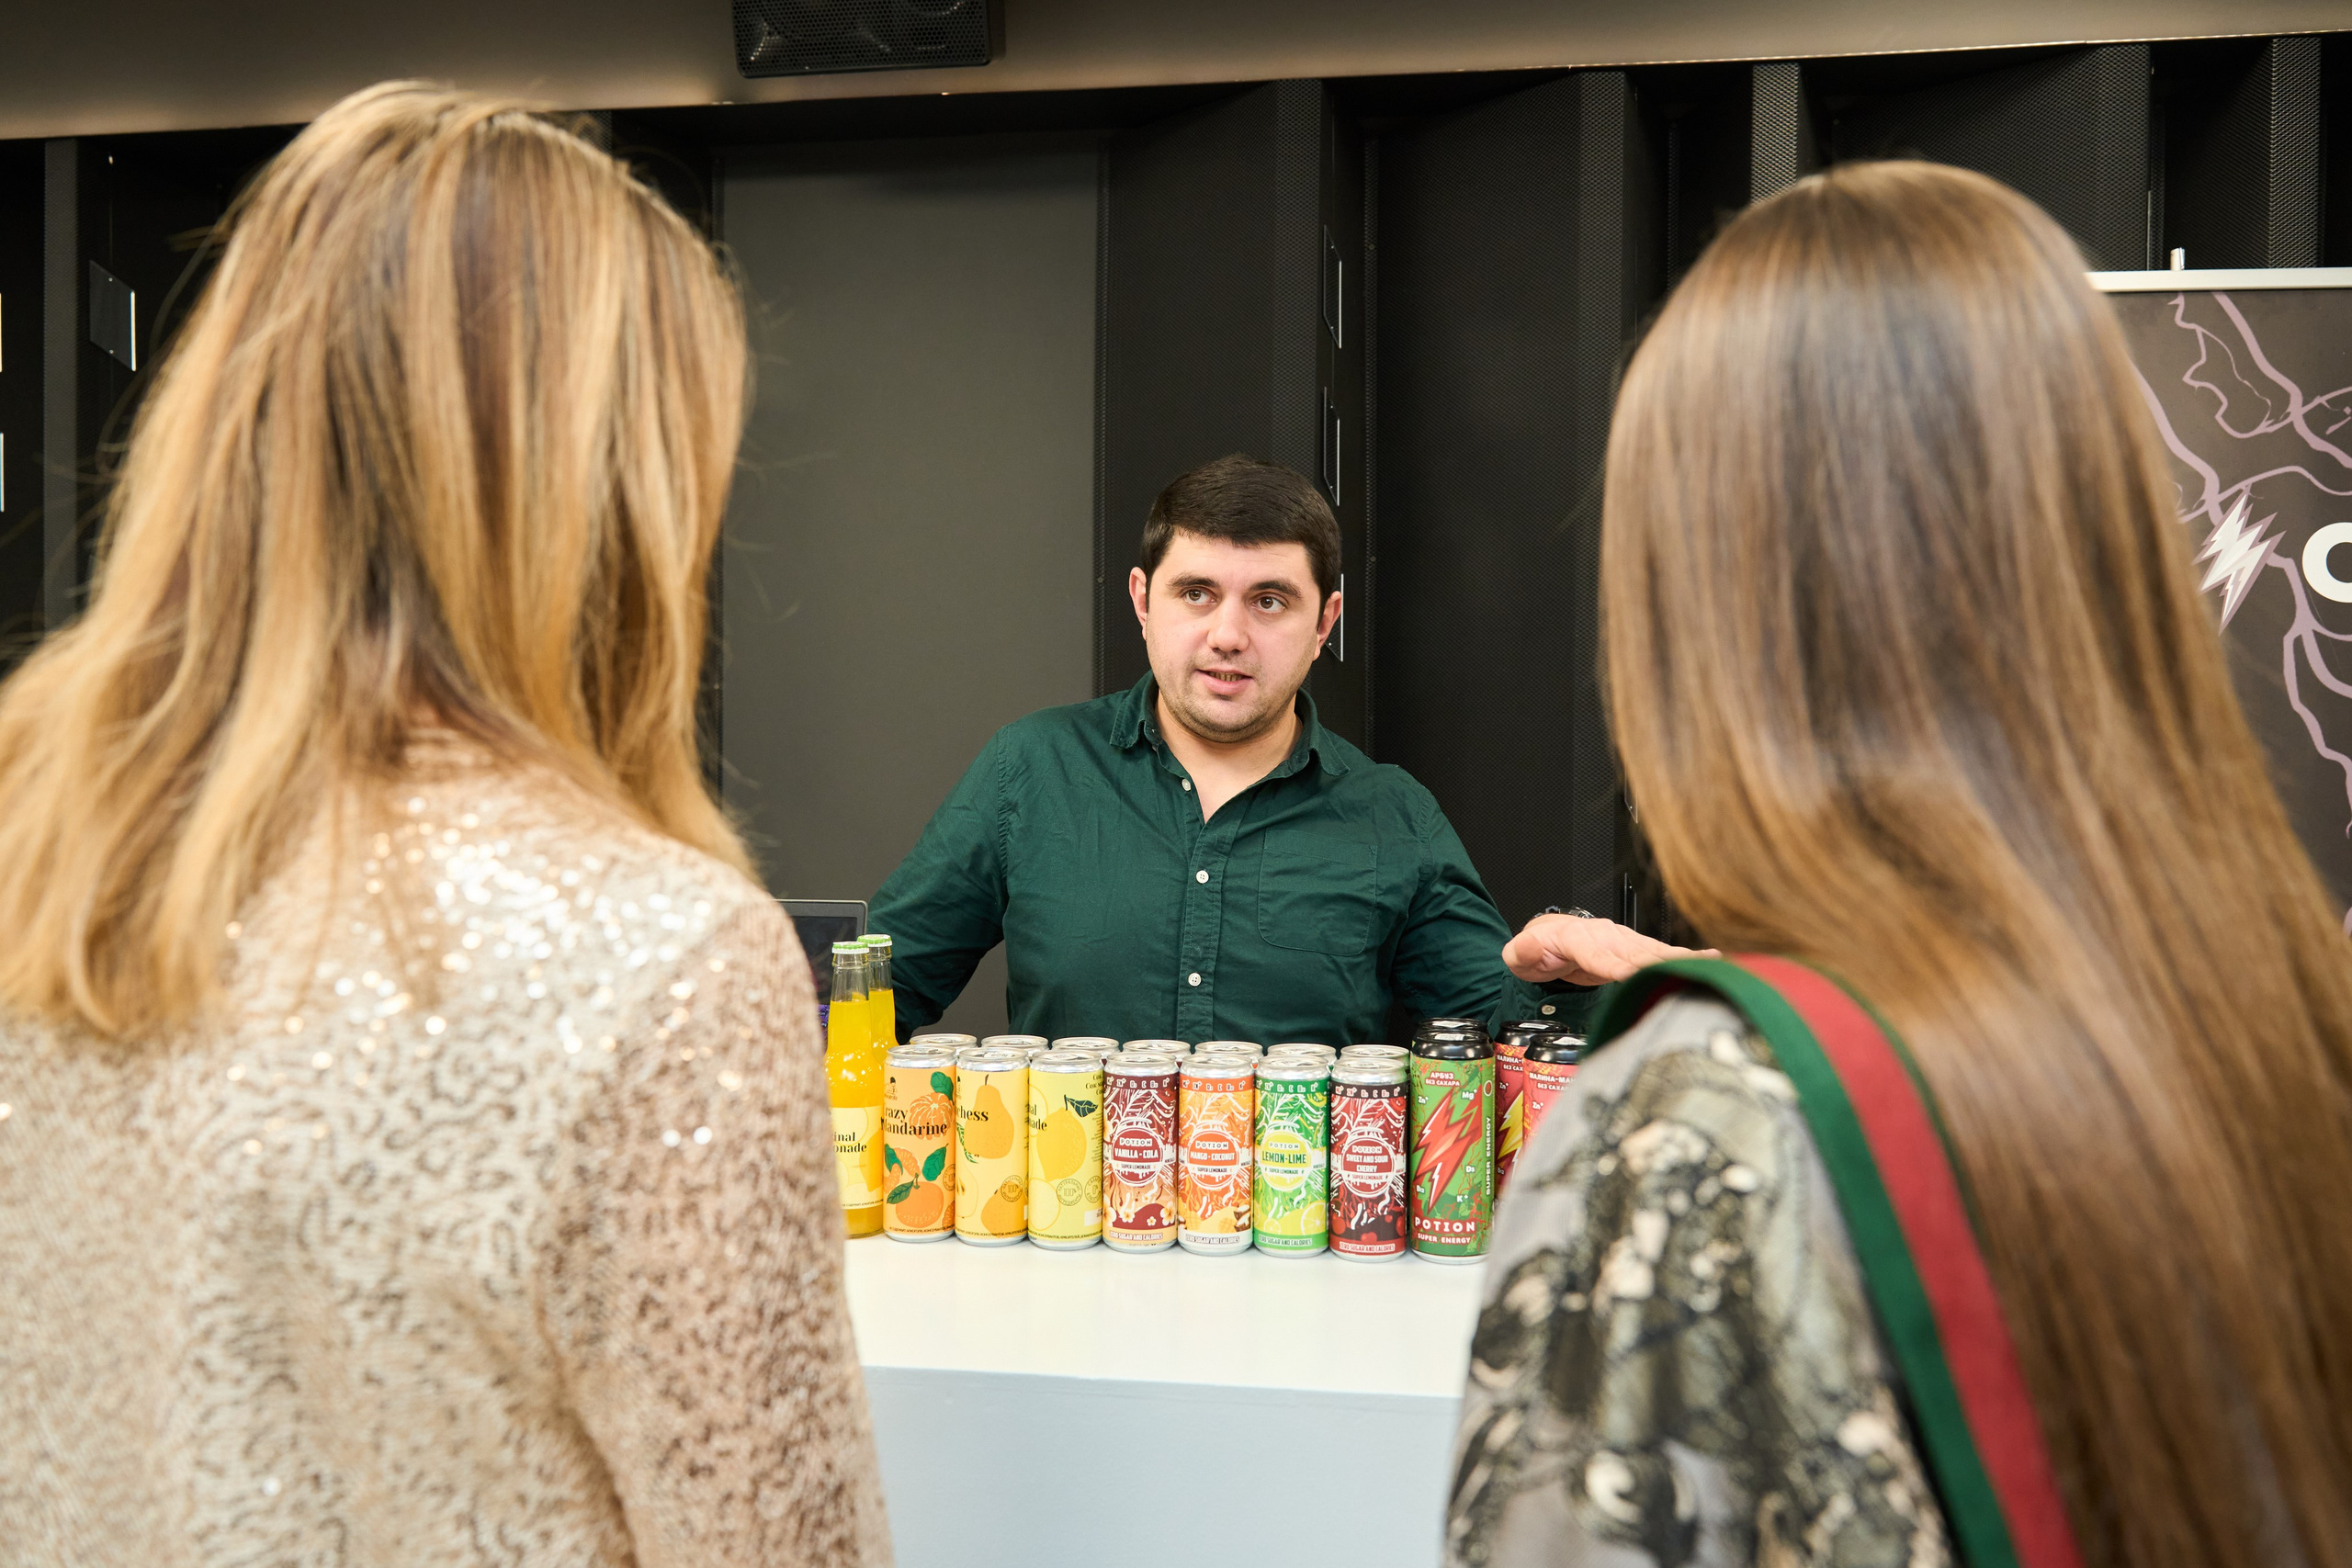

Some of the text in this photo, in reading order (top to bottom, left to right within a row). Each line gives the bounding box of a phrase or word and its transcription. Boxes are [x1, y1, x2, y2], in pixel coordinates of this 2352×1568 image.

[1497, 1055, 1523, 1064] МАЛИНА-
[1529, 1073, 1577, 1084] МАЛИНА-МАН
[885, 1106, 908, 1122] razy
[956, 1105, 989, 1122] chess
[833, 1132, 855, 1142] inal
[1120, 1138, 1152, 1146] POTION
[1196, 1141, 1228, 1149] POTION
[833, 1143, 866, 1153] onade
[1352, 1145, 1382, 1154] POTION
[1347, 1154, 1363, 1162] SWEET
[1415, 1217, 1475, 1232] POTION
[1418, 1233, 1438, 1242] SUPER
